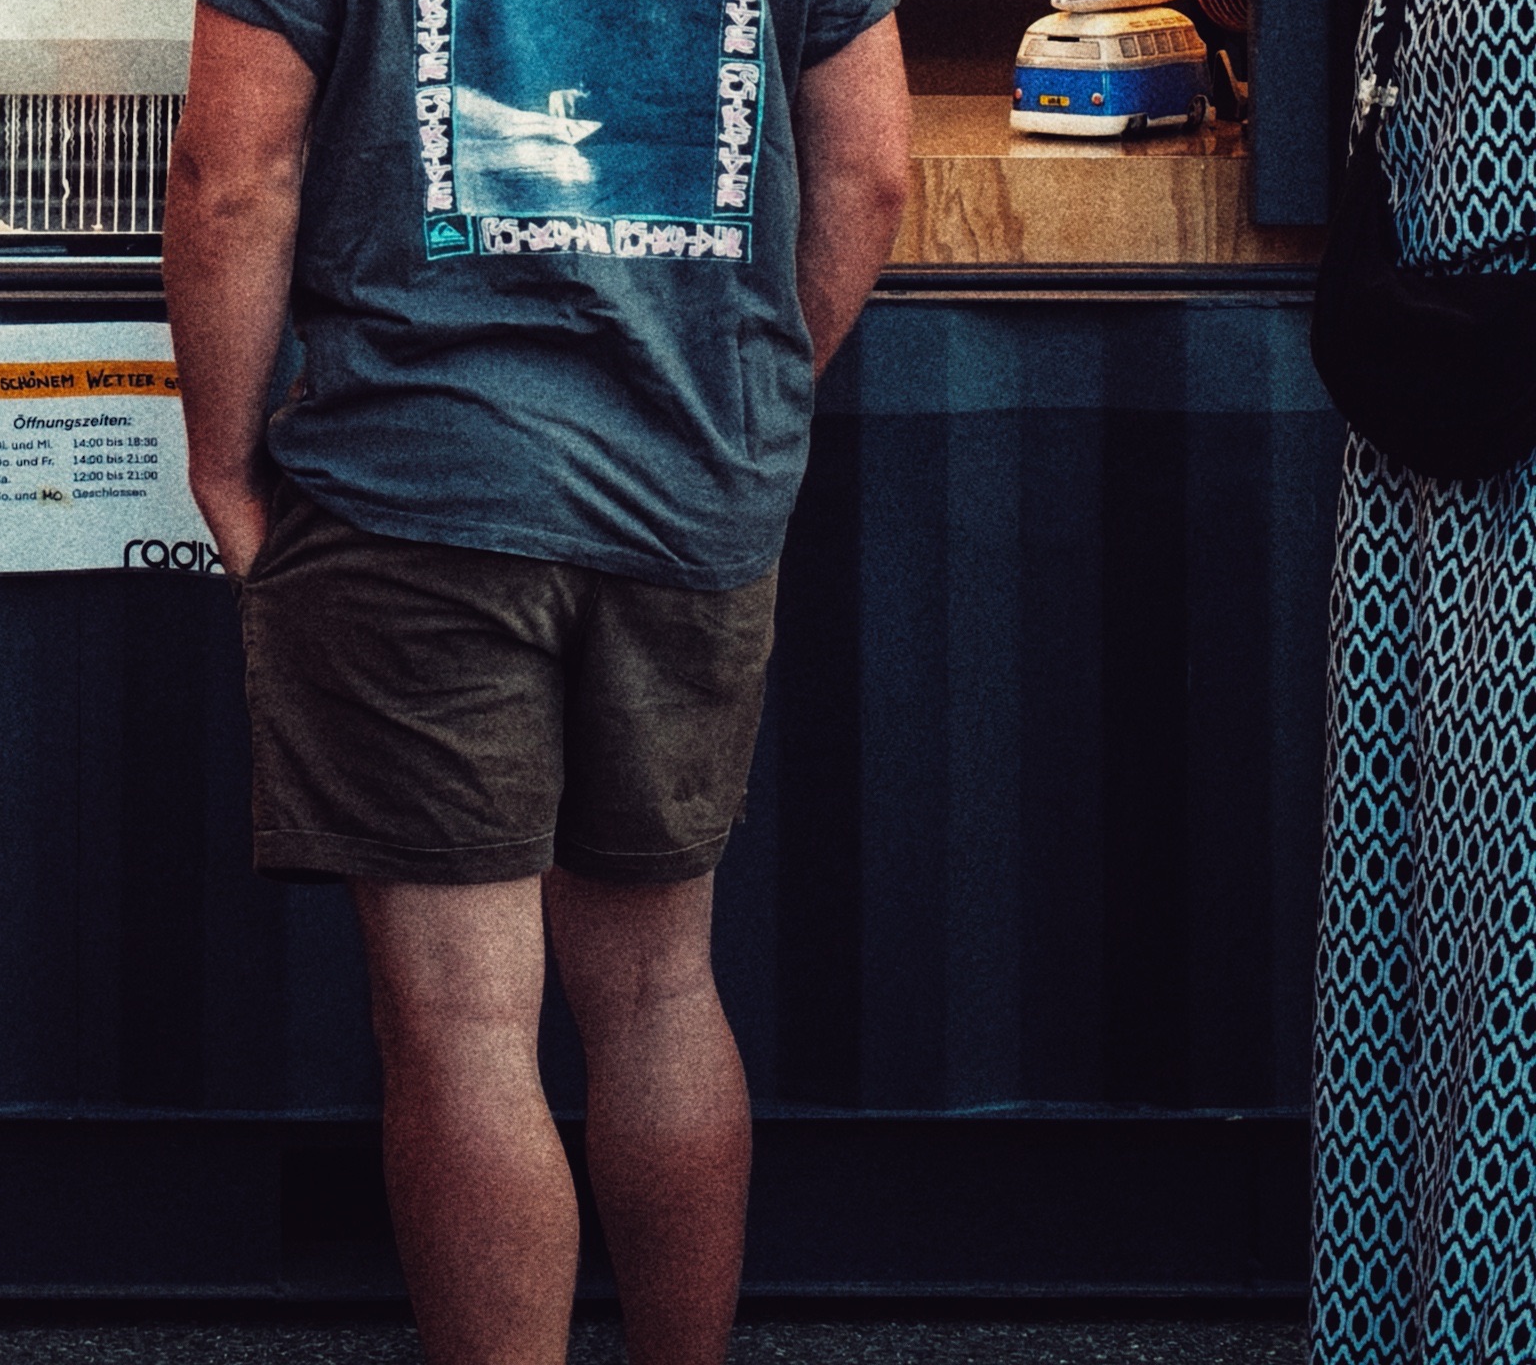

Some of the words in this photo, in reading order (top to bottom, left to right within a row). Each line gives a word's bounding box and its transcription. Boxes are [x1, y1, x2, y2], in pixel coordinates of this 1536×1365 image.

[0, 371, 75, 390] SCHÖNEM
[85, 369, 156, 388] WETTER
[13, 414, 132, 431] Öffnungszeiten:
[11, 440, 34, 451] und
[73, 438, 104, 449] 14:00
[106, 437, 124, 448] bis
[127, 437, 158, 447] 18:30
[16, 456, 39, 467] und
[73, 455, 104, 465] 14:00
[106, 454, 124, 464] bis
[126, 454, 158, 464] 21:00
[73, 471, 104, 482] 12:00
[106, 471, 124, 481] bis
[126, 470, 158, 481] 21:00
[14, 491, 37, 501] und
[72, 486, 147, 500] Geschlossen
